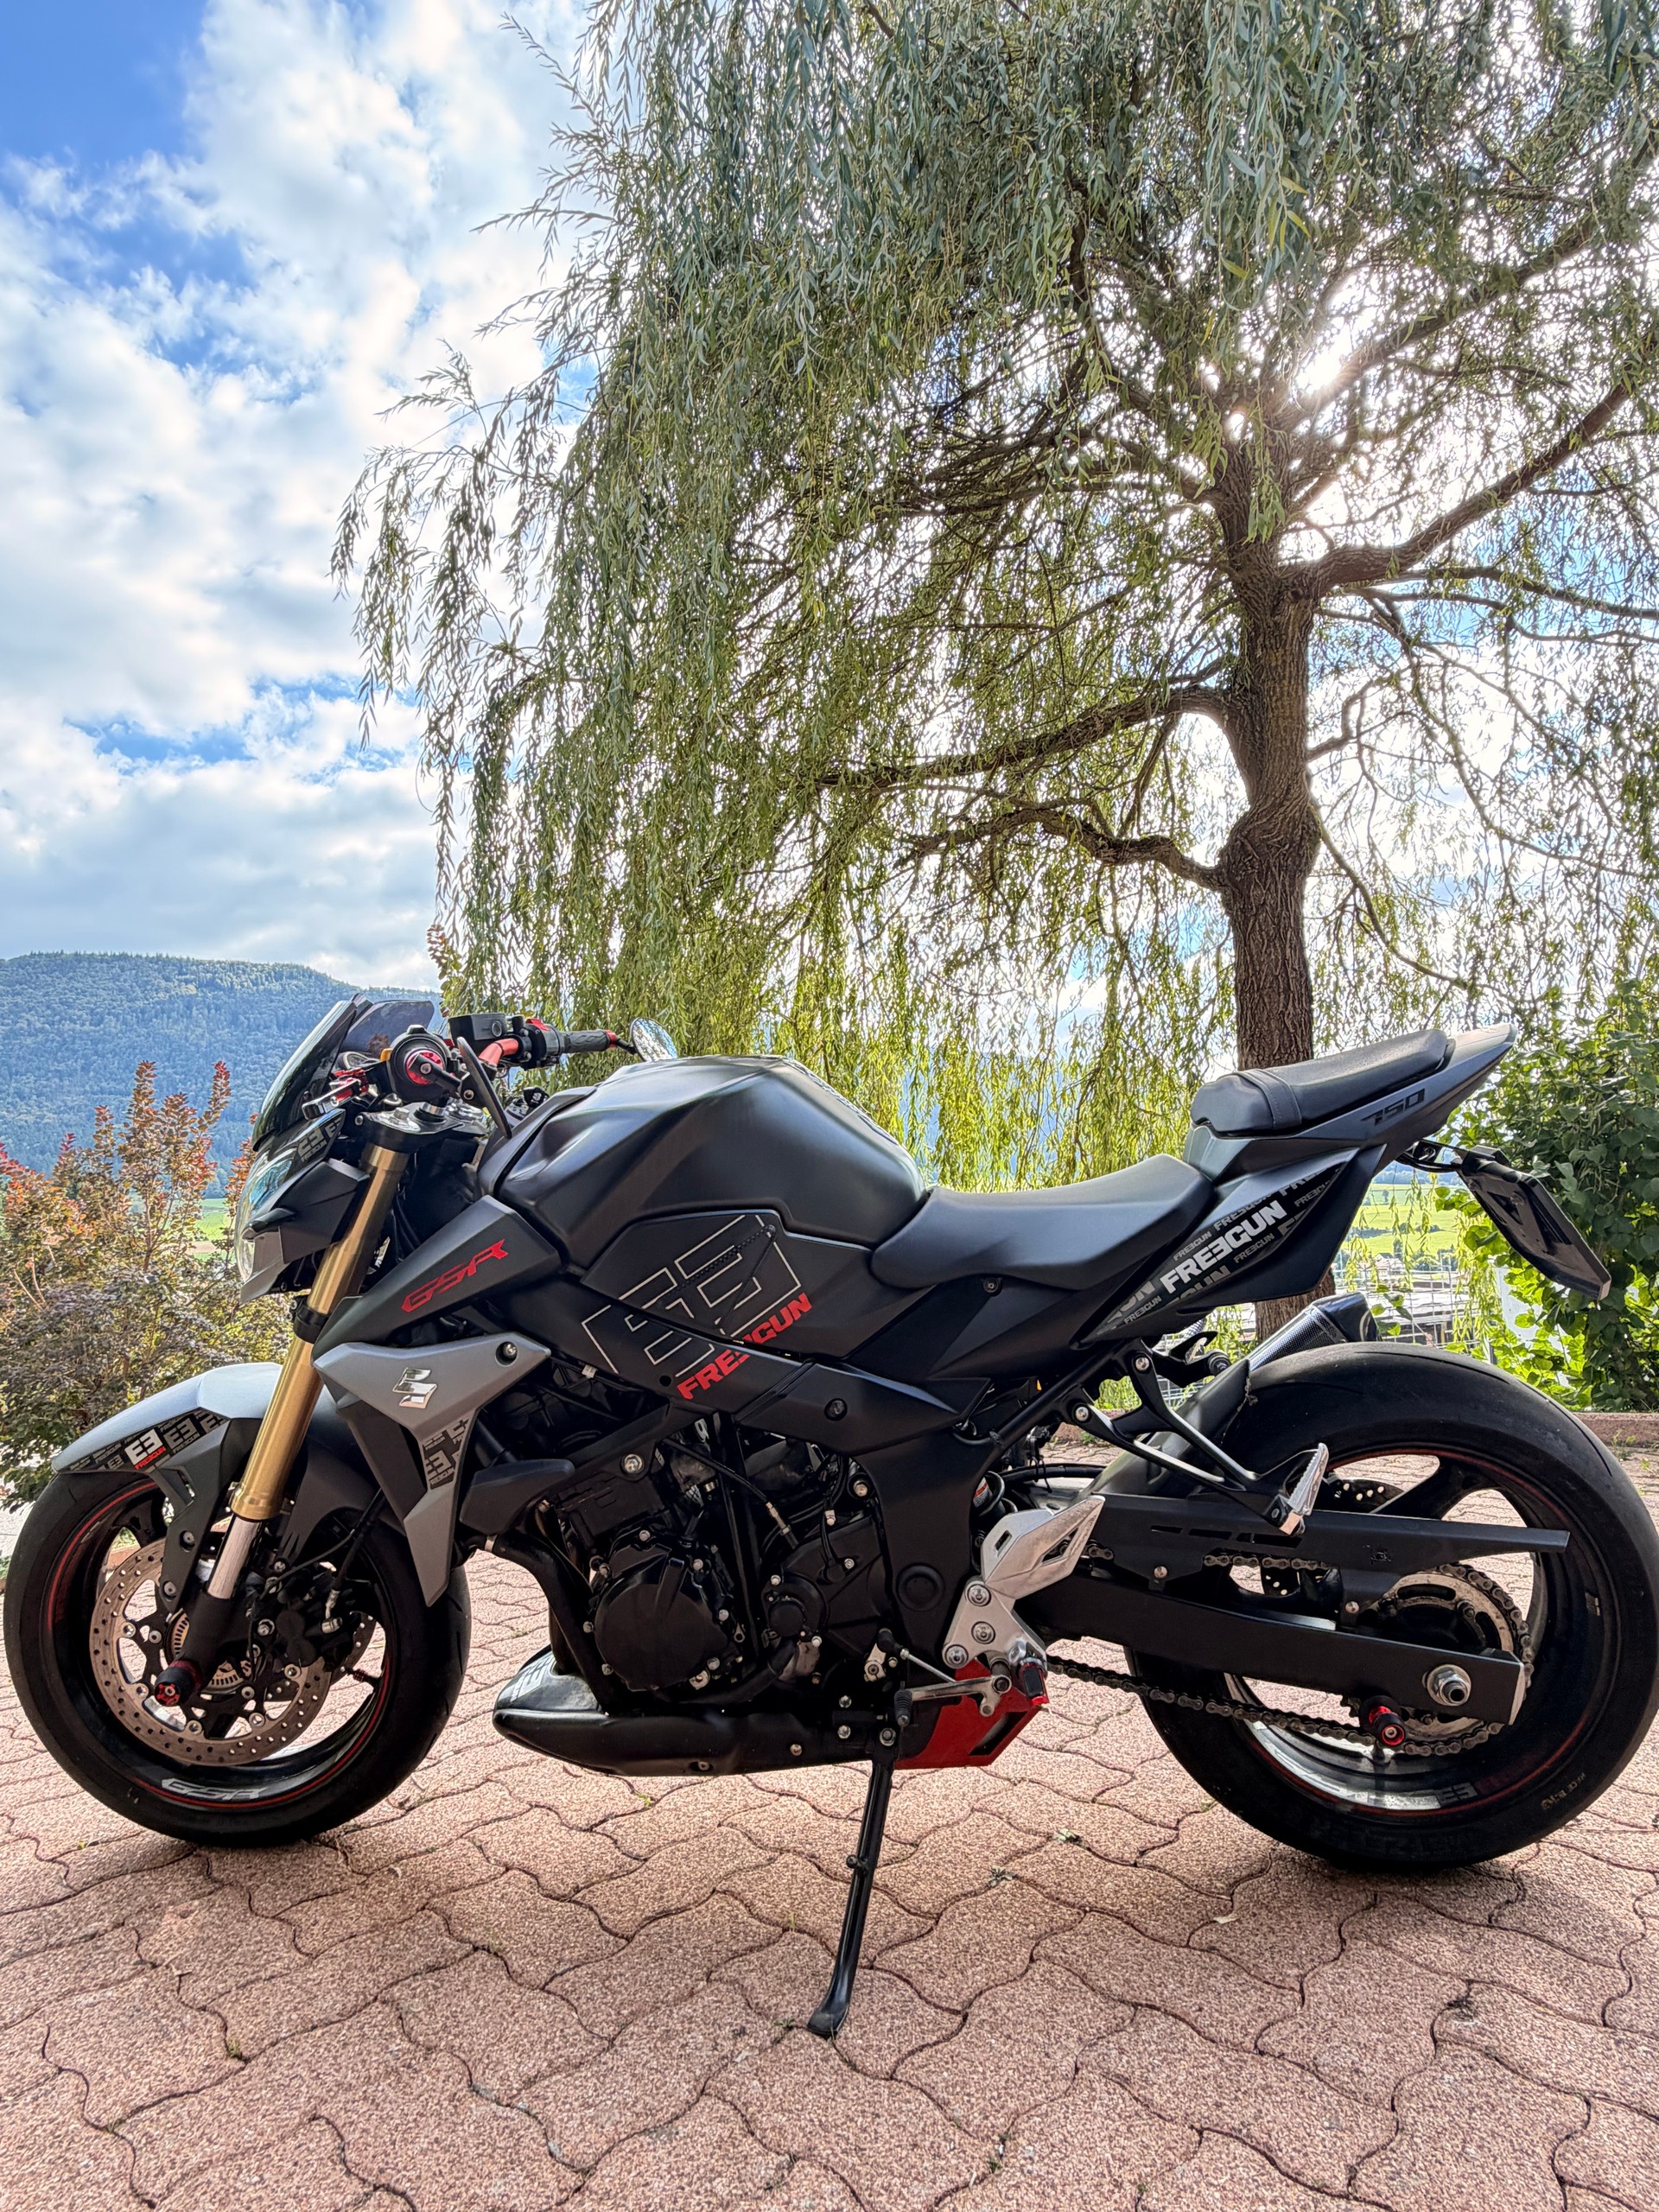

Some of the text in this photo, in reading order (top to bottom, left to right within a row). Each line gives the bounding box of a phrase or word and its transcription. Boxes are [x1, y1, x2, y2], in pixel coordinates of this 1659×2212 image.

[1361, 1089, 1425, 1126] 750
[401, 1238, 509, 1313] GSR
[162, 1777, 269, 1801] GSR
